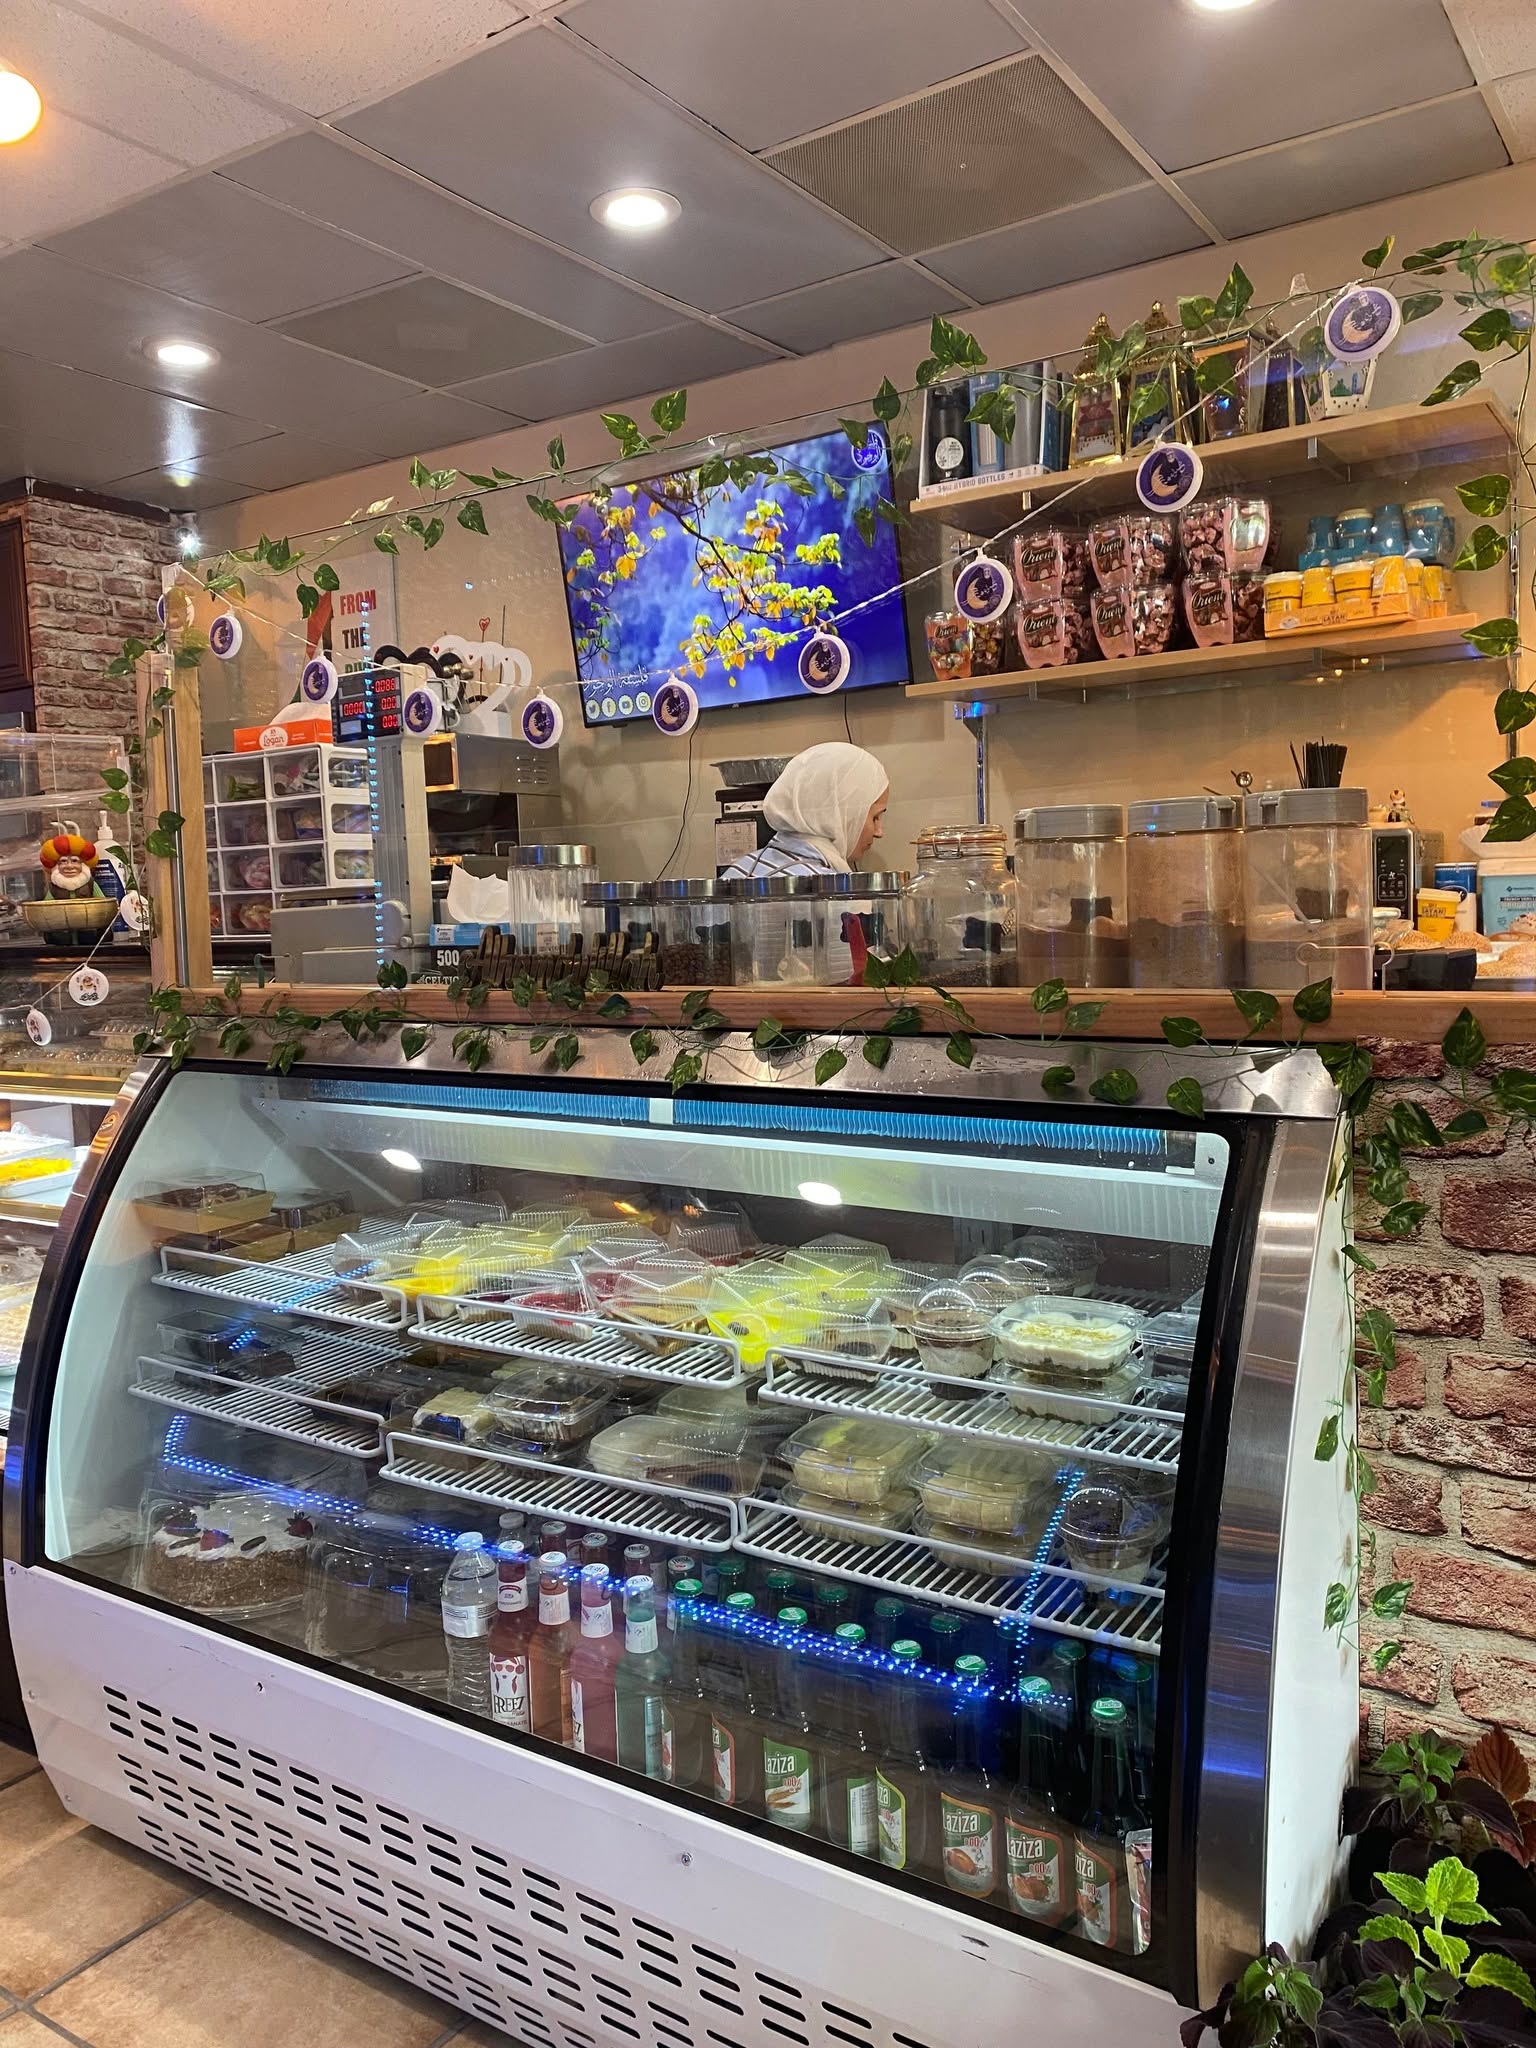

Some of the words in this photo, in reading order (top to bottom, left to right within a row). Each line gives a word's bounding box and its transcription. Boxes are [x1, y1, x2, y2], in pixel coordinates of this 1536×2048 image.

[977, 473, 1006, 485] BOTTLES
[339, 590, 377, 616] FROM
[342, 626, 367, 650] THE
[437, 950, 460, 967] 500
[493, 1694, 526, 1713] FREEZ
[764, 1752, 796, 1775] Laziza
[942, 1807, 979, 1834] Laziza
[1006, 1832, 1043, 1858] Laziza
[1075, 1851, 1095, 1879] ziza
